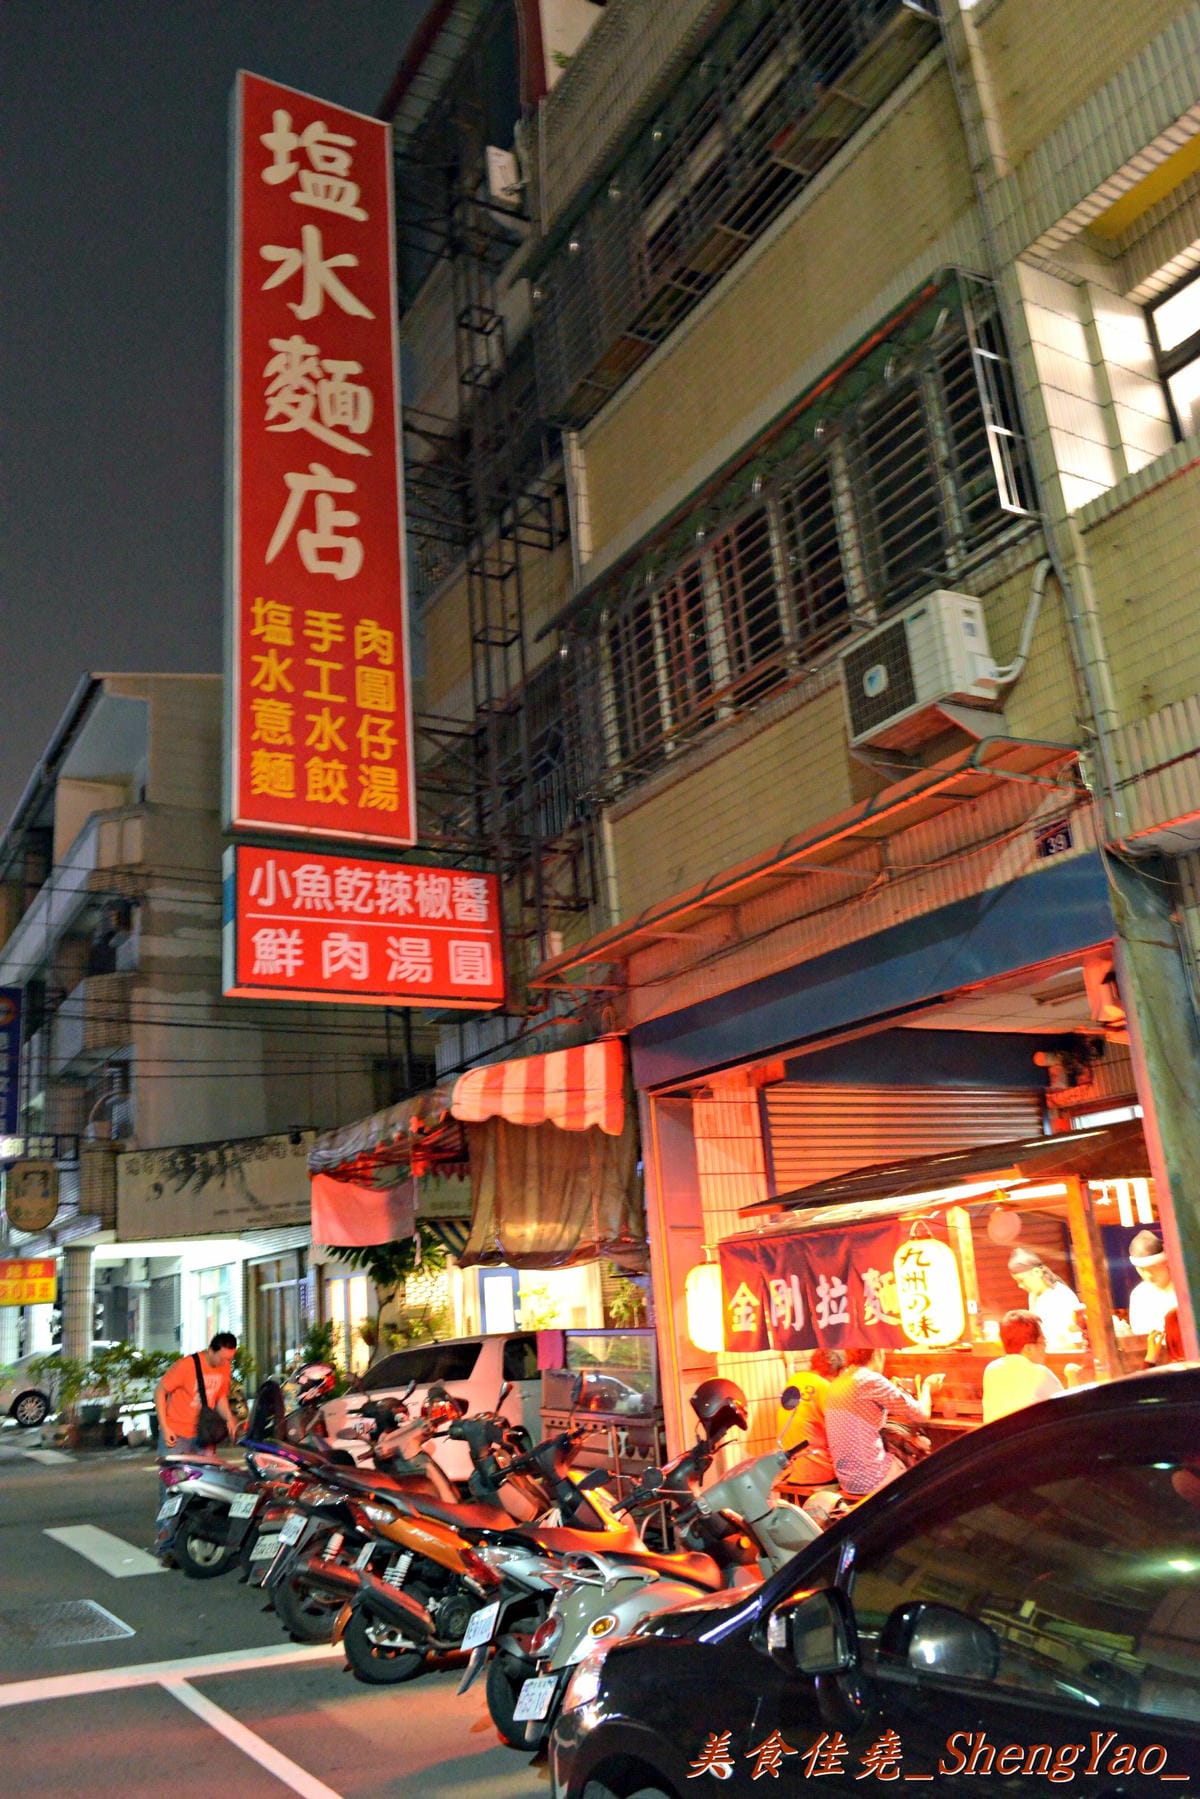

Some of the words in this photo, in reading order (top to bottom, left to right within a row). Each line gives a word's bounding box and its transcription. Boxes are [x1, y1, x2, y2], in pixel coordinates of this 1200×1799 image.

[259, 108, 376, 581] 塩水麵店
[249, 597, 297, 799] 塩水意麵
[302, 608, 350, 807] 手工水餃
[353, 618, 400, 813] 肉圓仔湯
[248, 859, 491, 924] 小魚乾辣椒醬
[250, 927, 494, 987] 鮮肉湯圓
[727, 1267, 902, 1334] 金剛拉麵
[899, 1247, 942, 1340] 九州の味
